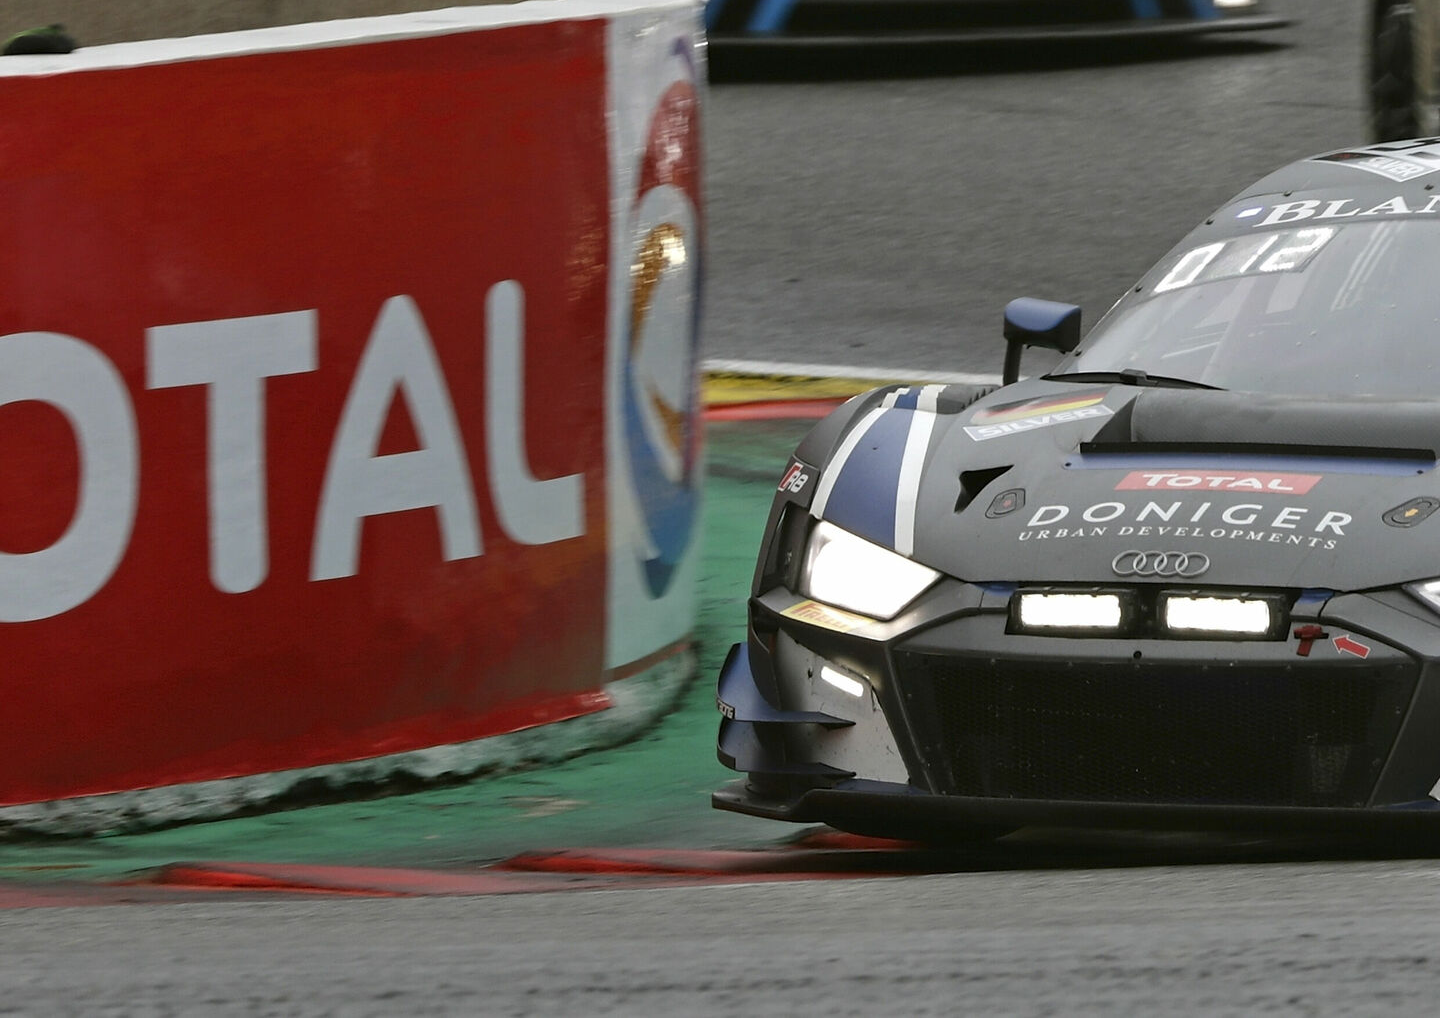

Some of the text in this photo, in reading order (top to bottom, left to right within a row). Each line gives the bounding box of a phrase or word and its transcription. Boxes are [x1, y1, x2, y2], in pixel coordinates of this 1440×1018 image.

[977, 408, 1099, 438] SILVER
[1142, 472, 1294, 492] TOTAL
[1026, 501, 1354, 536] DONIGER
[1018, 526, 1338, 551] URBAN DEVELOPMENTS
